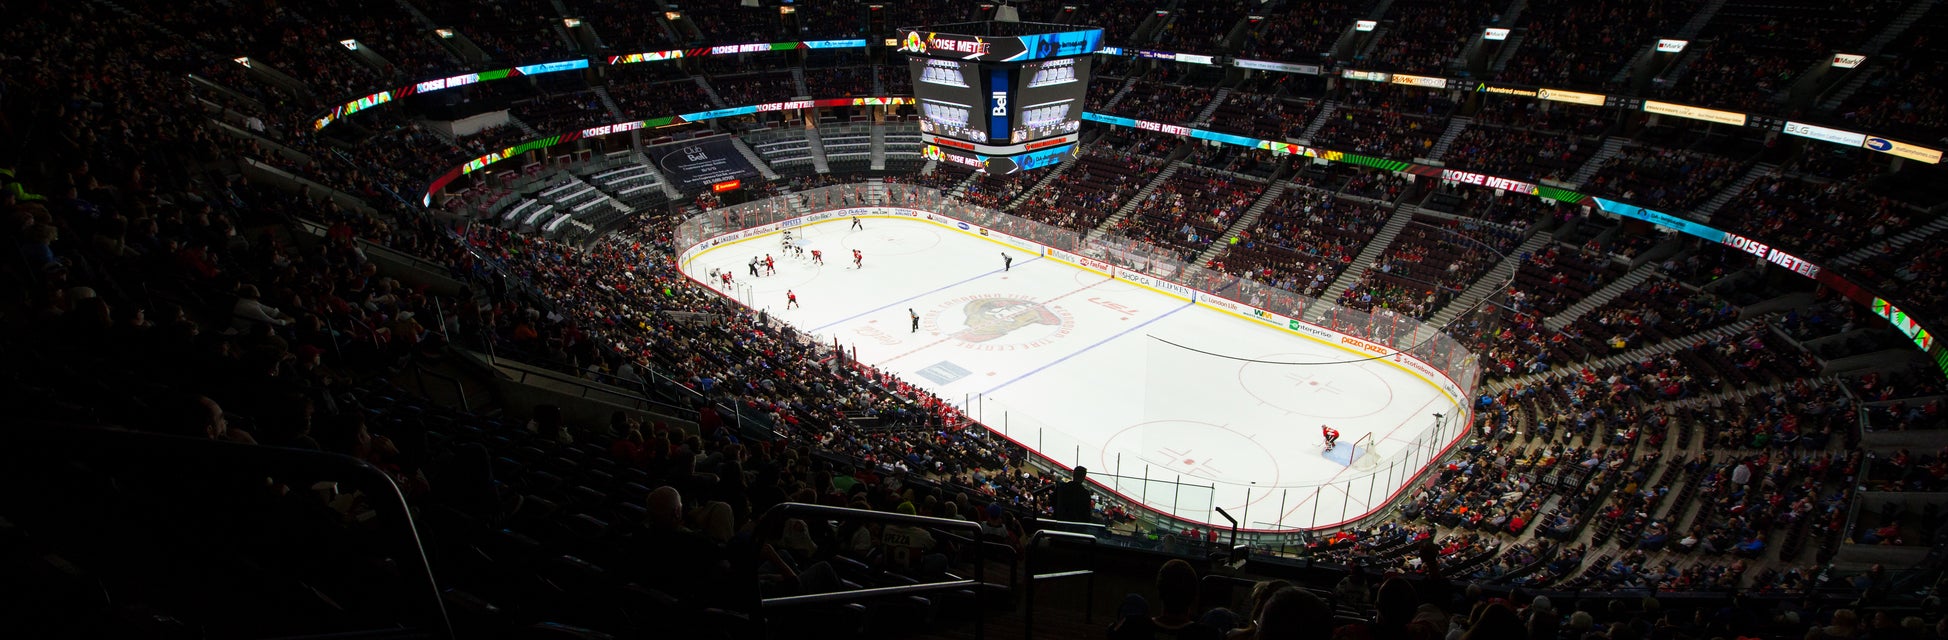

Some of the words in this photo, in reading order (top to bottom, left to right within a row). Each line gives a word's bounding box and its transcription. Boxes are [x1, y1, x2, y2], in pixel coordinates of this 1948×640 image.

[712, 45, 738, 55] NOISE
[739, 43, 771, 53] METER
[929, 38, 956, 50] NOISE
[957, 39, 991, 54] METER
[417, 78, 445, 93] NOISE
[446, 73, 479, 89] METER
[756, 102, 783, 112] NOISE
[783, 100, 815, 110] METER
[992, 91, 1007, 117] Bell
[582, 123, 611, 138] NOISE
[612, 120, 644, 133] METER
[1134, 119, 1161, 132] NOISE
[1161, 123, 1192, 137] METER
[1786, 124, 1809, 135] BLG
[683, 146, 702, 155] Club
[687, 153, 708, 162] Bell
[946, 153, 965, 165] NOISE
[1442, 169, 1484, 185] NOISE
[1485, 176, 1539, 195] METER
[1721, 232, 1768, 258] NOISE
[1768, 248, 1822, 279] METER
[1208, 297, 1228, 308] London
[1228, 302, 1238, 311] Life
[1253, 308, 1273, 320] WM
[1290, 322, 1332, 339] enterprise
[1341, 335, 1363, 348] pizza
[1364, 342, 1387, 355] pizza
[1403, 357, 1435, 378] Scotiabank
